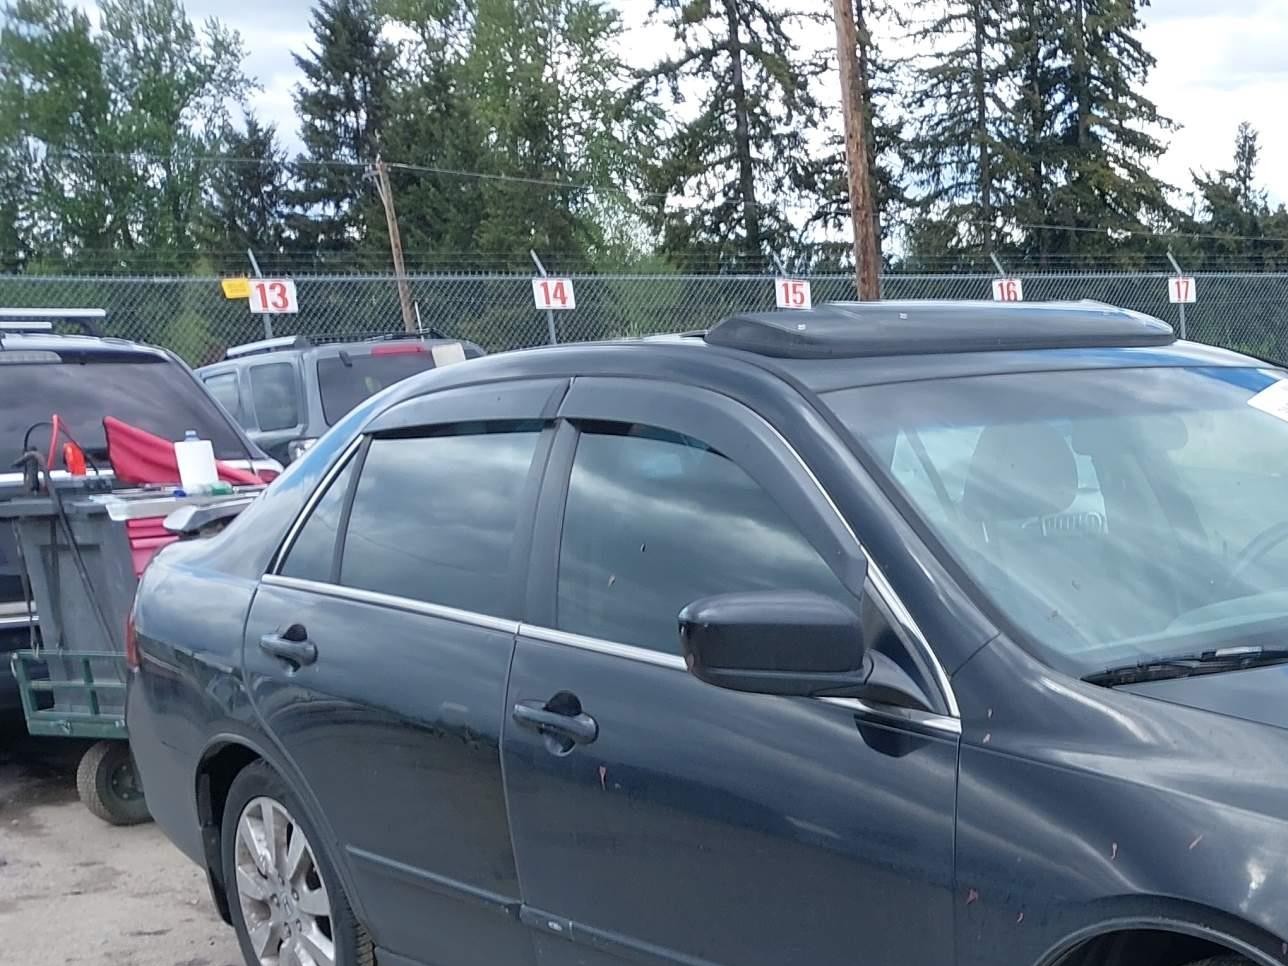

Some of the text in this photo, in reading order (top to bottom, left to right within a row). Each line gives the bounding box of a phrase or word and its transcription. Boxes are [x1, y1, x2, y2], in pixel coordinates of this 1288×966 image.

[256, 282, 289, 310] 13
[542, 281, 568, 305] 14
[781, 282, 805, 306] 15
[998, 280, 1018, 301] 16
[1174, 279, 1190, 300] 17
